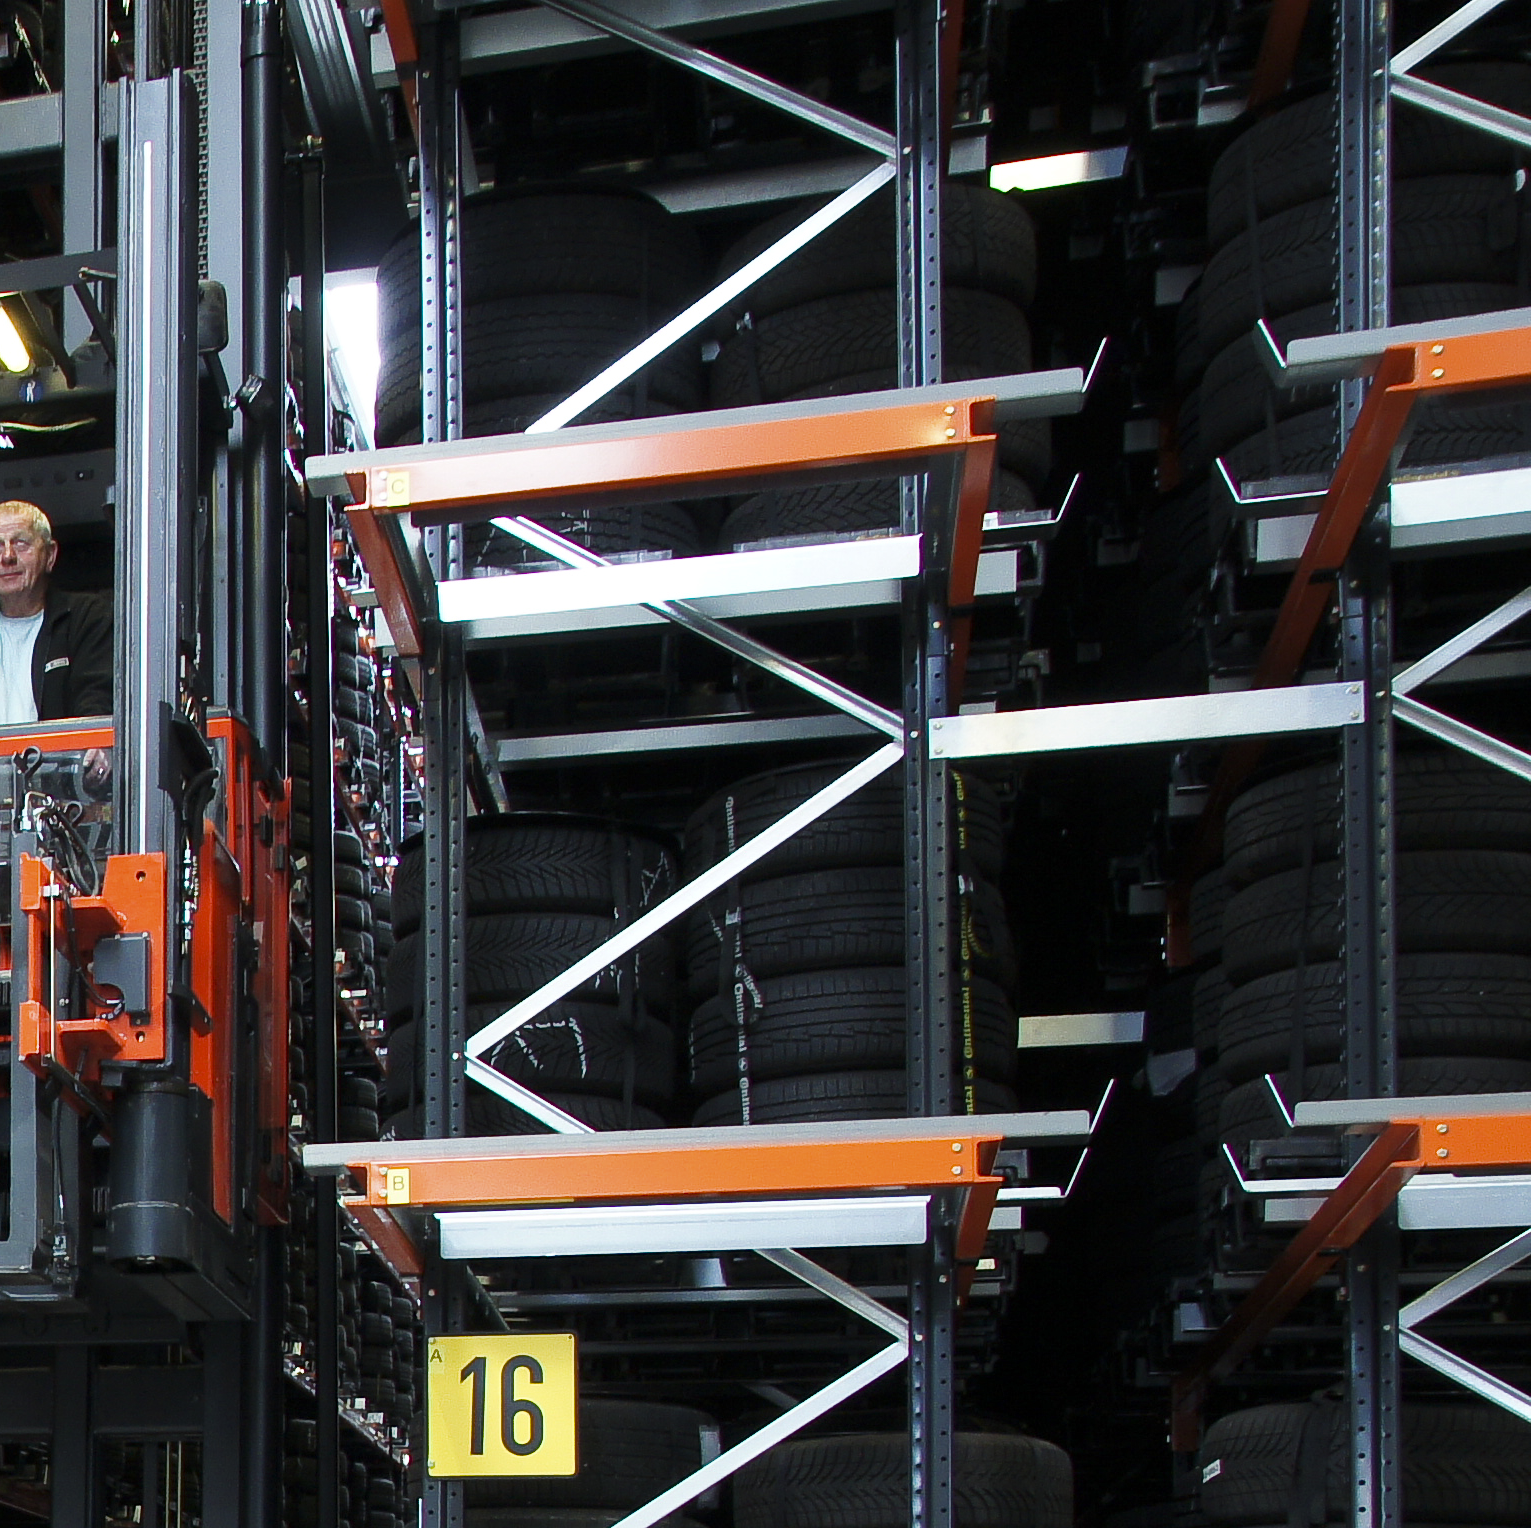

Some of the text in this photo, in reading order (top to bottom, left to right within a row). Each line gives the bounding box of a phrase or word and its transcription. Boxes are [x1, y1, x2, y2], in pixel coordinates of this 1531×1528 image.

[393, 1175, 405, 1191] B
[430, 1348, 443, 1363] A
[460, 1355, 544, 1456] 16
